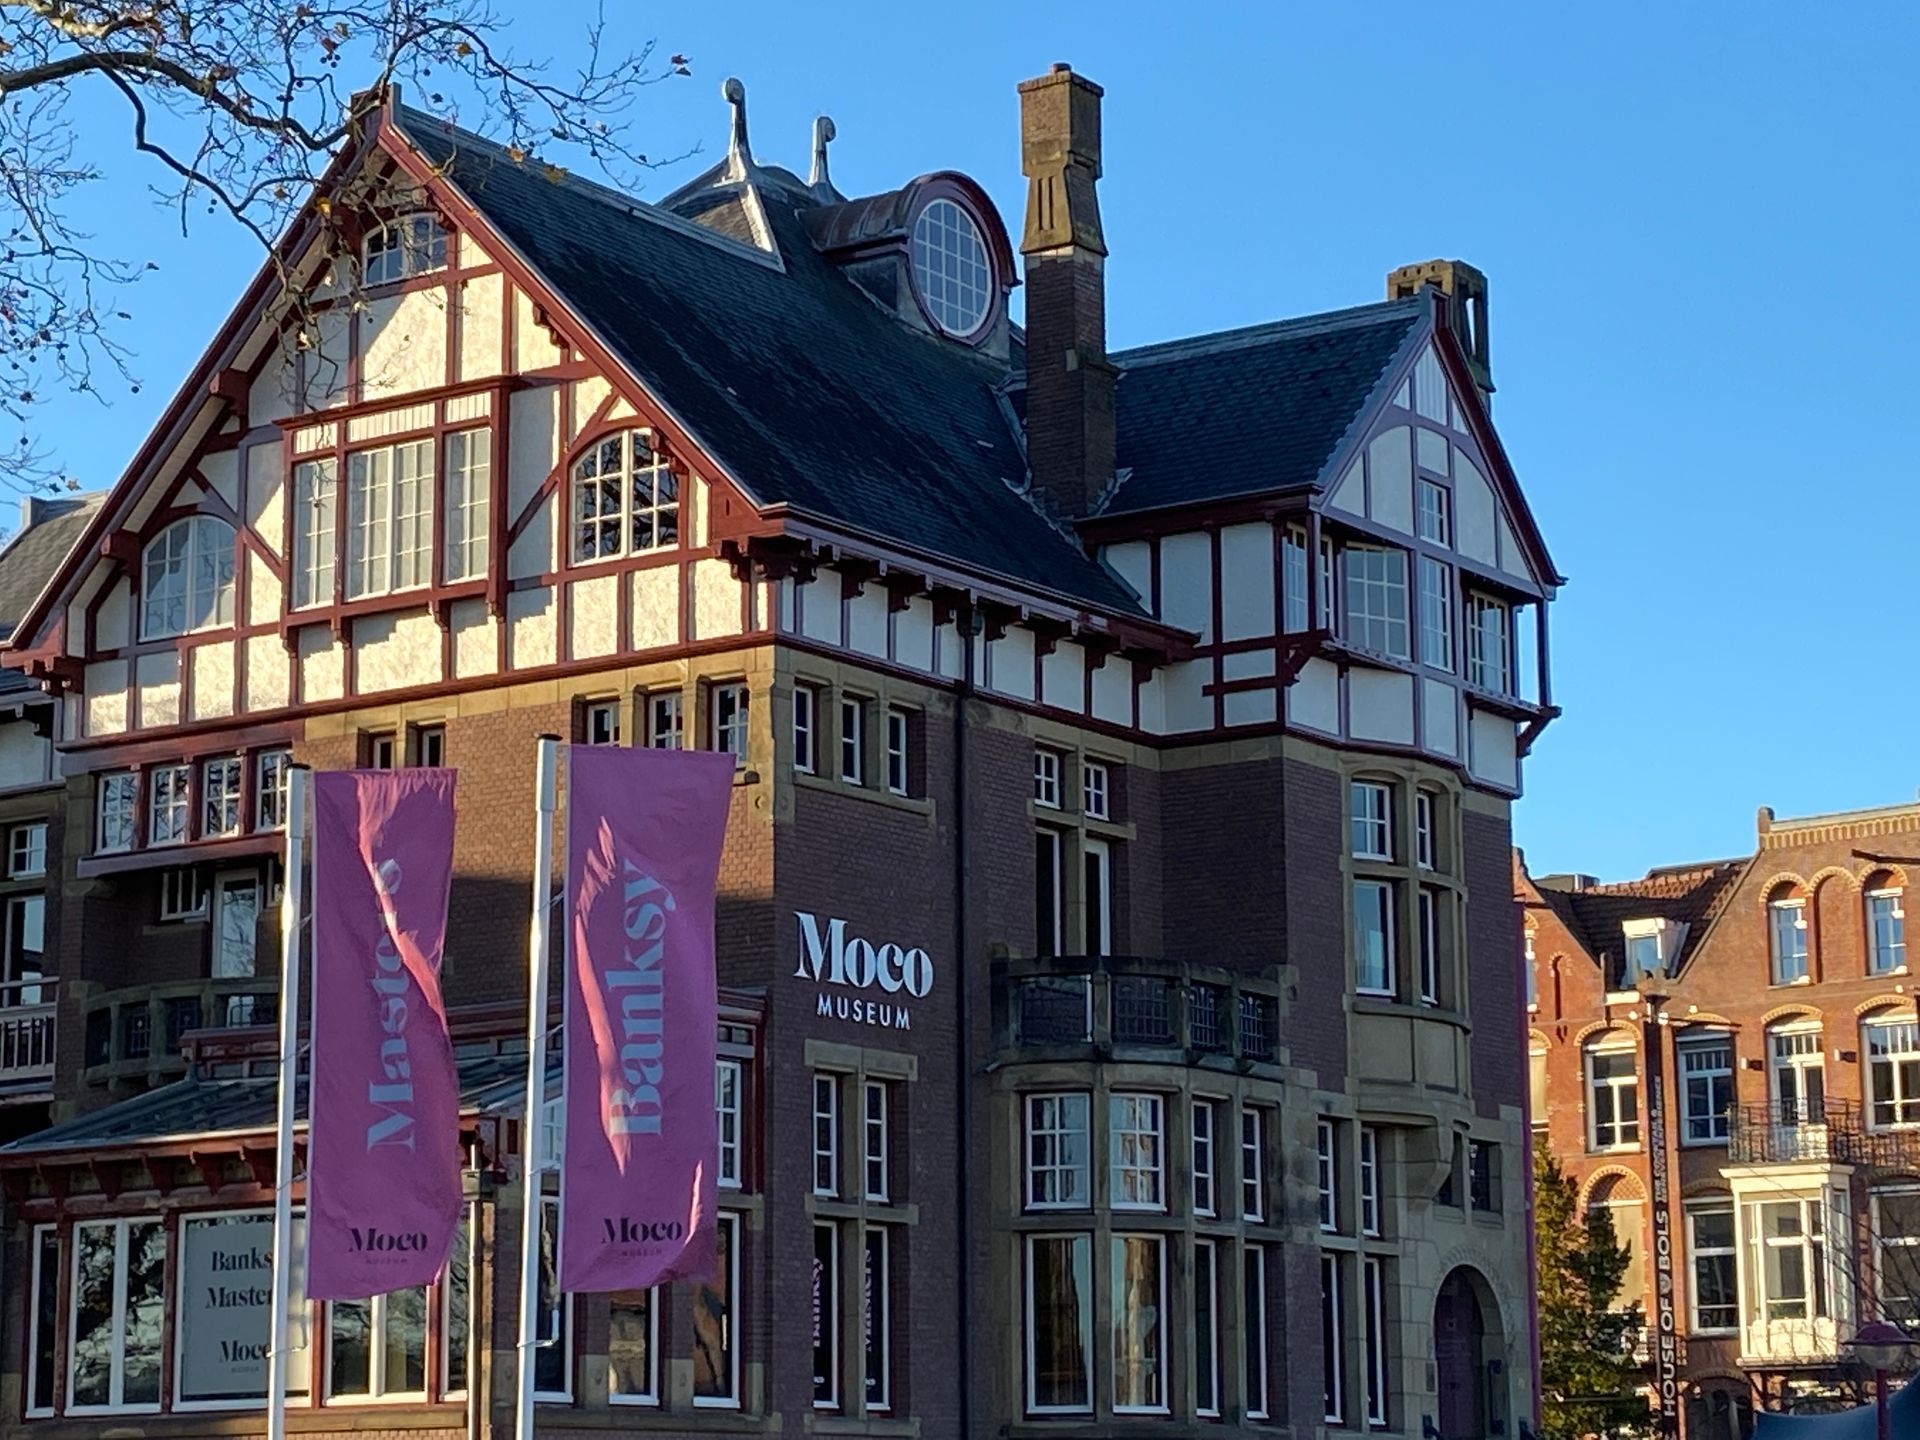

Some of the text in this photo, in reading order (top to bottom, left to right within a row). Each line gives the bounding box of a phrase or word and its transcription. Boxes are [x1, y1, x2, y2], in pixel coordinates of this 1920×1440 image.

[793, 911, 934, 998] Moco
[367, 859, 415, 1152] Mastes
[604, 859, 677, 1136] Banksy
[816, 993, 911, 1031] MUSEUM
[348, 1227, 429, 1252] Moco
[601, 1217, 682, 1244] Moco
[1656, 1210, 1671, 1270] BOLS
[211, 1247, 273, 1271] Banks
[206, 1286, 272, 1308] Master
[1660, 1297, 1673, 1331] OF
[1661, 1336, 1675, 1416] HOUSE
